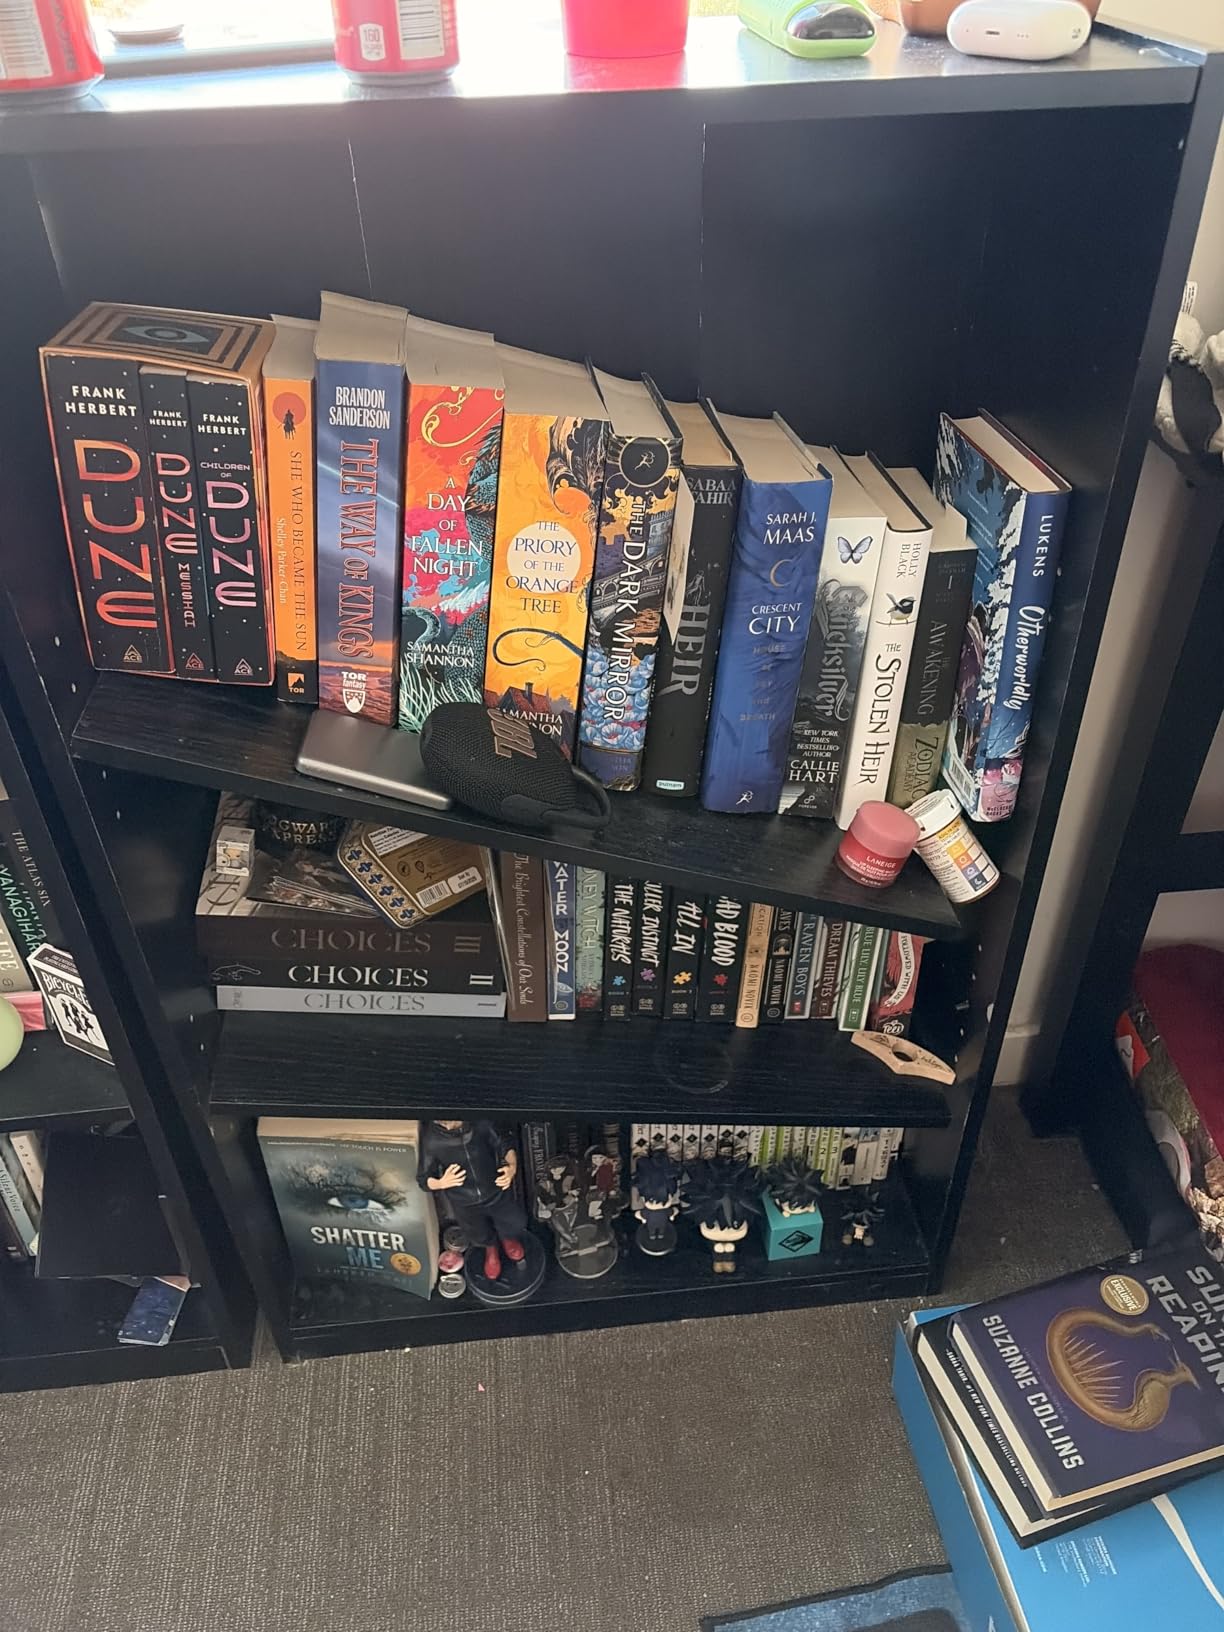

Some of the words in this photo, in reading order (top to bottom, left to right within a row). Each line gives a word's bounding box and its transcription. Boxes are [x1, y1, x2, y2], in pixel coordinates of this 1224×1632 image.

[72, 385, 126, 400] FRANK
[335, 386, 385, 409] BRANDON
[65, 402, 137, 417] HERBERT
[153, 410, 182, 418] FRANK
[203, 414, 239, 424] FRANK
[329, 407, 390, 429] SANDERSON
[149, 418, 188, 428] HERBERT
[197, 425, 247, 436] HERBERT
[200, 462, 250, 471] CHILDREN
[290, 451, 302, 481] SHE
[340, 438, 380, 496] THE
[444, 477, 455, 488] A
[154, 452, 198, 555] DUNE
[291, 487, 304, 525] WHO
[427, 493, 470, 512] DAY
[339, 500, 378, 557] WAY
[438, 519, 458, 532] OF
[537, 520, 559, 532] THE
[629, 501, 647, 535] THE
[766, 513, 807, 525] SARAH
[810, 512, 817, 524] J.
[73, 439, 158, 629] DUNE
[206, 481, 257, 608] DUNE
[276, 517, 287, 549] Shelley
[763, 527, 815, 545] MAAS
[411, 536, 483, 556] FALLEN
[514, 537, 577, 557] PRIORY
[1032, 514, 1054, 577] LUKENS
[292, 530, 305, 586] BECAME
[344, 558, 370, 581] OF
[413, 557, 478, 577] NIGHT
[524, 560, 540, 570] OF
[542, 561, 565, 572] THE
[896, 543, 911, 578] BLACK
[908, 543, 922, 577] HOLLY
[506, 575, 579, 594] ORANGE
[615, 541, 647, 614] DARK
[178, 563, 196, 628] MESSIAH
[294, 592, 306, 619] THE
[520, 597, 562, 614] TREE
[337, 582, 374, 659] KINGS
[752, 603, 803, 615] CRESCENT
[749, 615, 801, 635] CITY
[296, 625, 307, 651] SUN
[407, 641, 475, 656] SAMANTHA
[886, 643, 902, 653] THE
[407, 653, 475, 668] SHANNON
[658, 604, 710, 696] HEIR
[1003, 605, 1046, 711] Otherworldly
[341, 671, 368, 682] TOR
[602, 622, 637, 721] MIRROR
[917, 620, 948, 715] AWAKENING
[342, 680, 367, 690] fantasy
[867, 654, 902, 733] STOLEN
[496, 707, 563, 724] MANTHA
[790, 760, 840, 772] CALLIE
[852, 742, 890, 787] HEIR
[911, 736, 939, 799] ZODIAC
[788, 770, 838, 784] HART
[11, 828, 30, 853] THE
[22, 853, 44, 888] ATLAS
[37, 887, 52, 908] SIX
[513, 852, 529, 869] The
[866, 855, 897, 868] LANEIGE
[511, 872, 529, 906] Brightest
[614, 884, 634, 906] THE
[676, 901, 703, 928] ALL
[715, 896, 742, 919] AD
[580, 906, 600, 950] WITCH
[756, 904, 766, 937] CATION
[778, 908, 793, 931] AVES
[271, 928, 431, 953] CHOICES
[515, 909, 532, 958] Constellations
[609, 907, 633, 965] NATURALS
[640, 913, 660, 968] INSTINCT
[671, 930, 697, 956] IN
[711, 922, 740, 967] BLOOD
[798, 922, 815, 963] RAVEN
[827, 923, 843, 958] DREAM
[862, 926, 875, 948] BLUE
[554, 929, 569, 973] MOON
[288, 964, 429, 988] CHOICES
[518, 969, 533, 984] Our
[773, 959, 785, 981] NAOMI
[794, 966, 809, 996] BOYS
[821, 960, 837, 998] THIEVES
[855, 967, 868, 985] LILY
[41, 970, 89, 1004] BICYCLE
[519, 985, 534, 1005] Souls
[770, 982, 782, 1005] NOVIK
[852, 985, 865, 1004] BLUE
[304, 992, 426, 1011] CHOICES
[831, 1146, 838, 1154] 3
[310, 1226, 406, 1252] SHATTER
[346, 1247, 385, 1269] ME
[1110, 1279, 1138, 1311] EXCLUSIVE
[1192, 1301, 1217, 1326] ON
[982, 1314, 1040, 1390] SUZANNE
[1026, 1391, 1085, 1470] COLLINS
